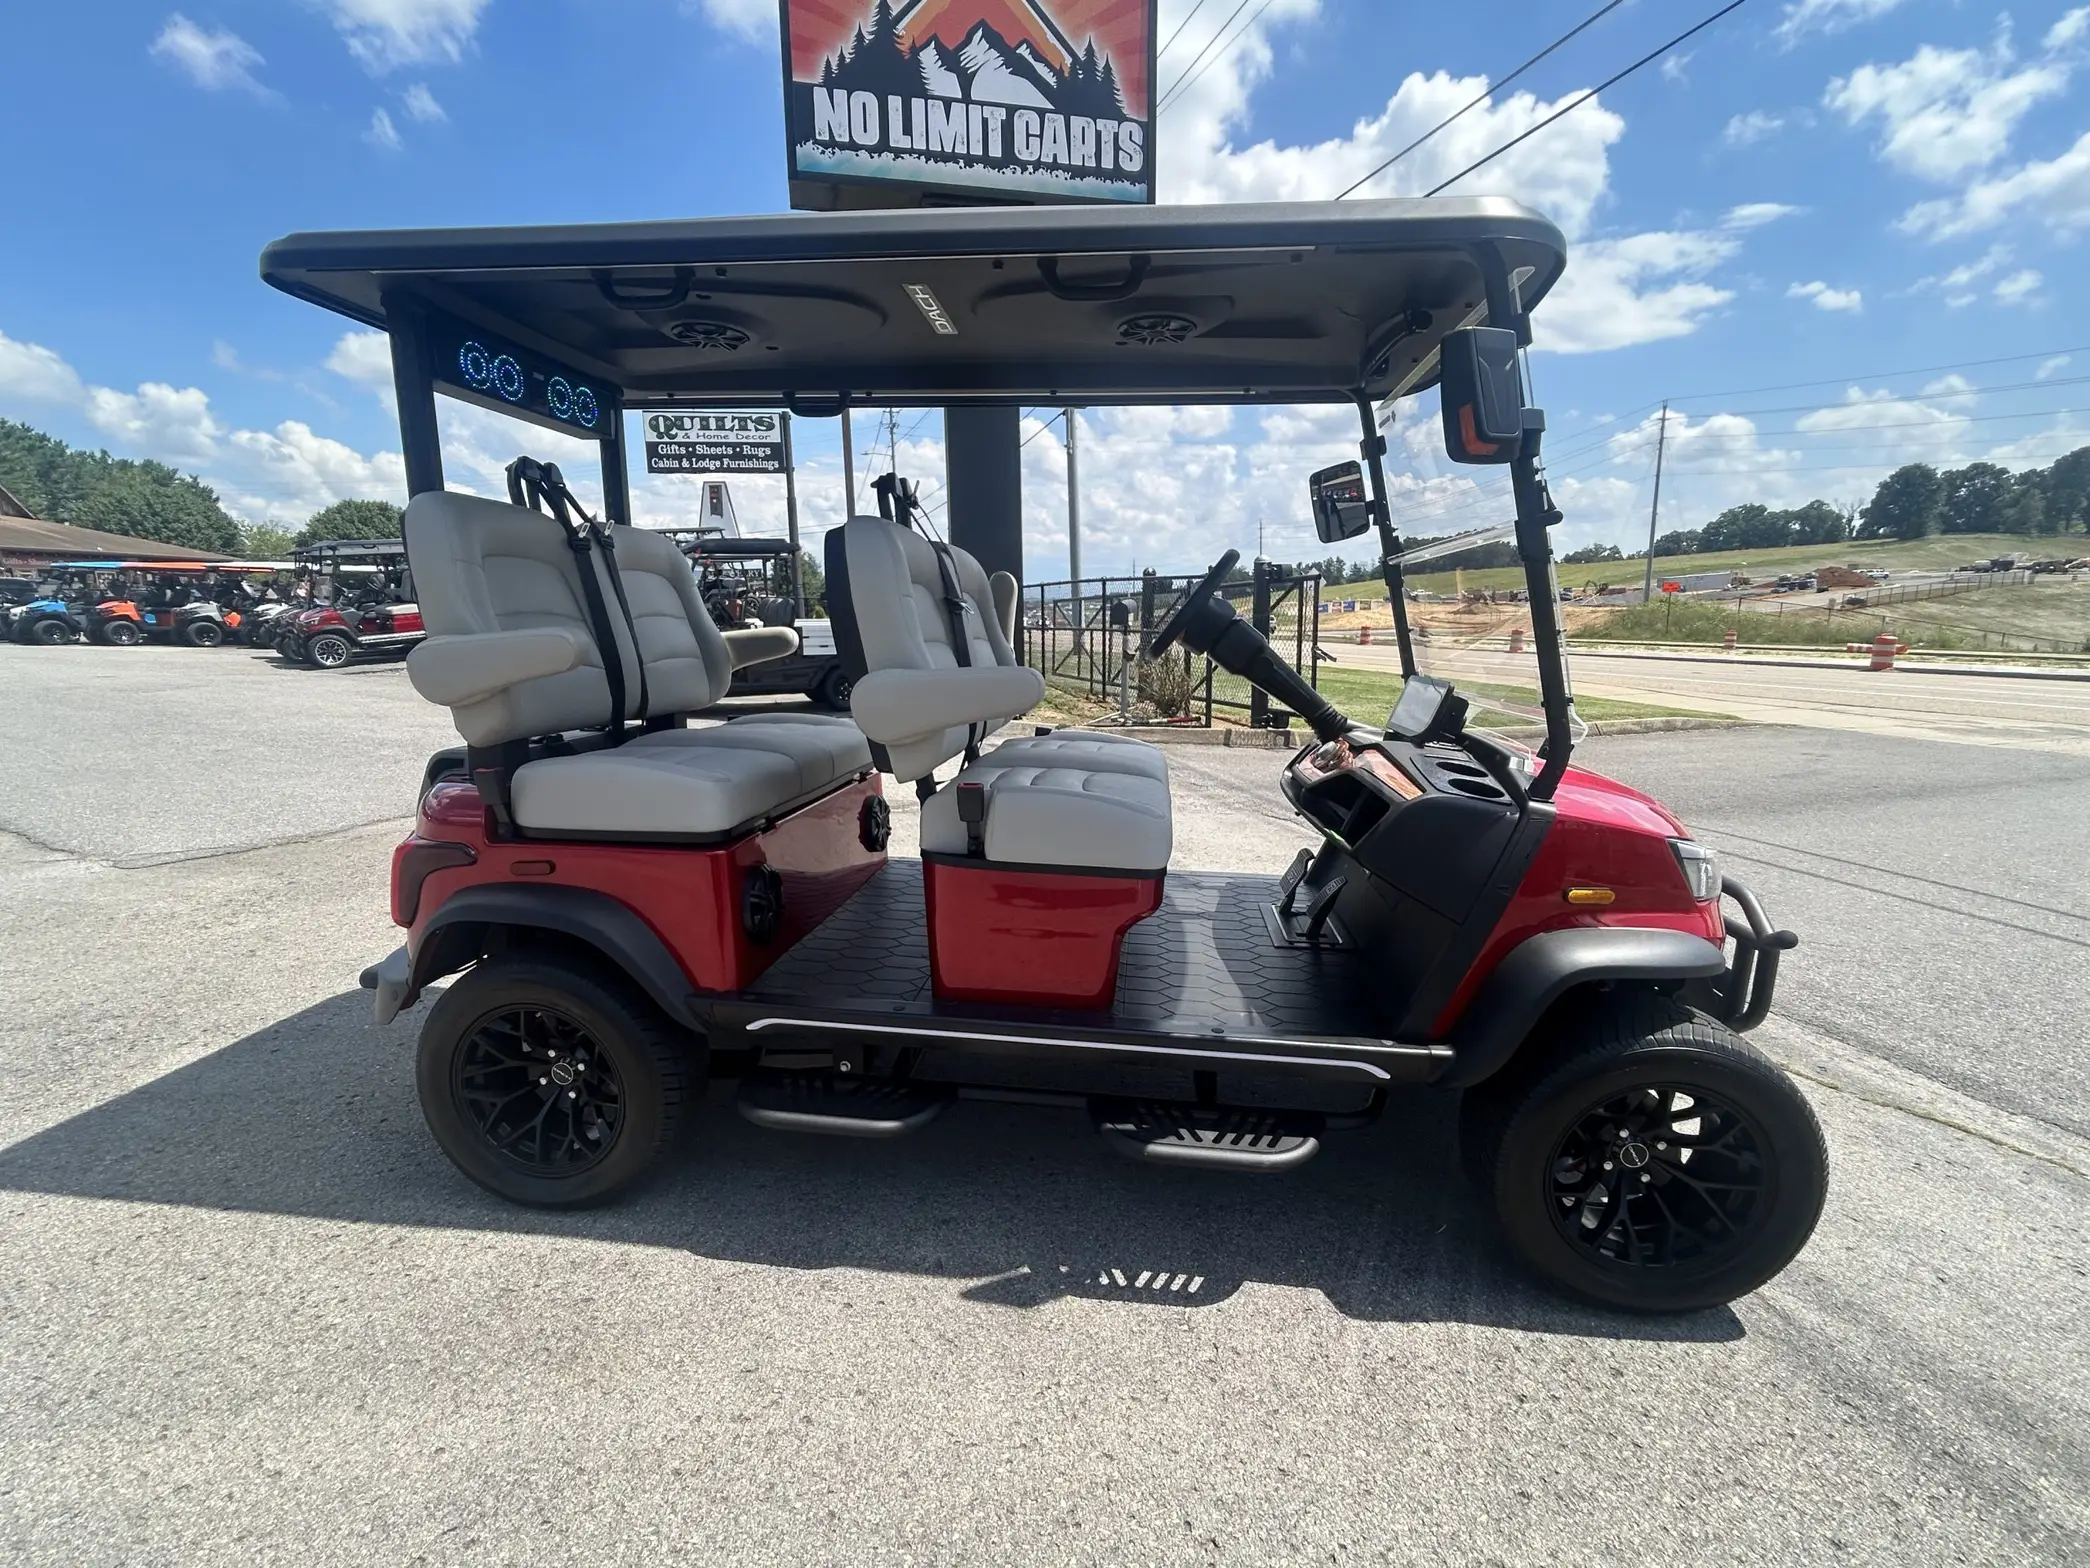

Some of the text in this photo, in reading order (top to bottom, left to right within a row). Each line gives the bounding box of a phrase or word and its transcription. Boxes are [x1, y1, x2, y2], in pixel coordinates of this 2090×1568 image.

[812, 86, 1144, 173] NO LIMIT CARTS
[908, 285, 953, 332] DACH
[648, 414, 776, 440] QUILTS
[682, 432, 771, 441] & Home Decor
[658, 444, 771, 457] Gifts Sheets Rugs
[651, 457, 779, 470] Cabin & Lodge Furnishings
